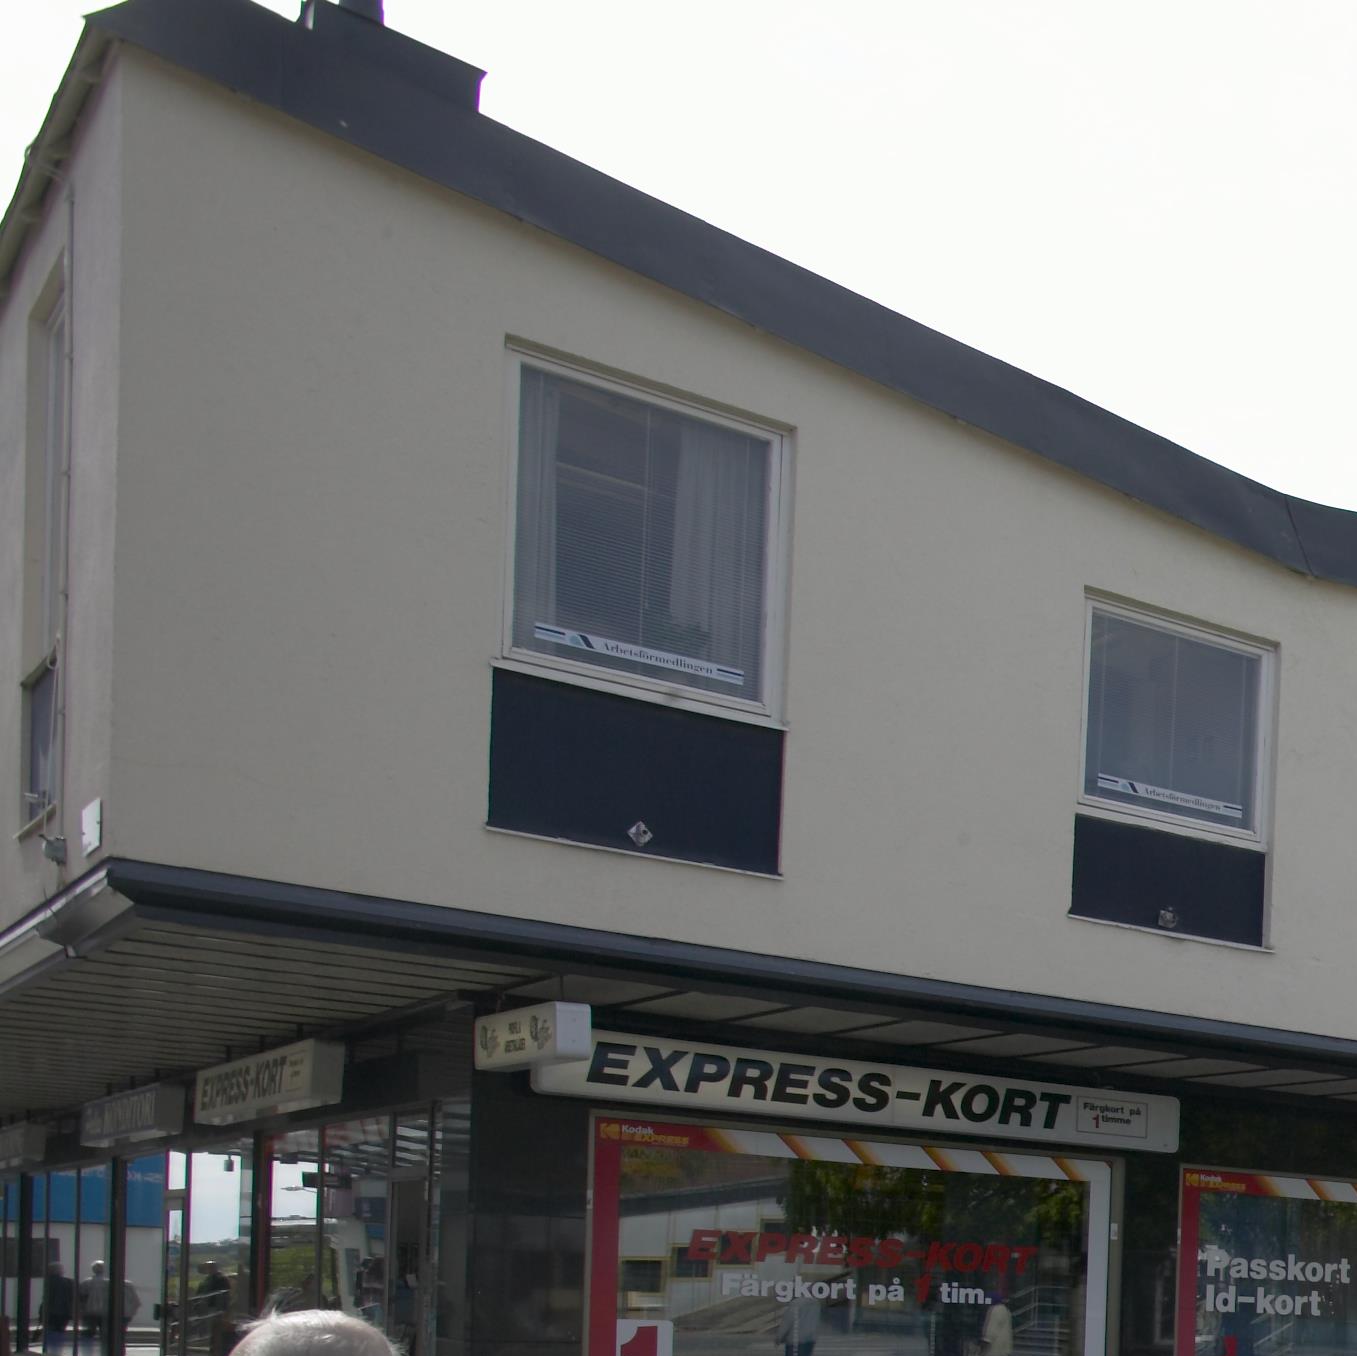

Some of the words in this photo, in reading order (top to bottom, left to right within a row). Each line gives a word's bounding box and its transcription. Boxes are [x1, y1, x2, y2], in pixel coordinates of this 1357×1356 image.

[603, 641, 713, 675] Arbetsförmedlingen
[200, 1056, 287, 1111] EXPRESS-KORT
[586, 1042, 1071, 1131] EXPRESS-KORT
[1083, 1102, 1124, 1115] Färgkort
[1129, 1107, 1142, 1117] på
[1092, 1113, 1100, 1128] 1
[1101, 1115, 1131, 1125] timme
[622, 1124, 654, 1135] Kodak
[687, 1229, 1039, 1276] EXPRESS-KORT
[1206, 1250, 1351, 1284] Passkort
[721, 1272, 857, 1303] Färgkort
[868, 1277, 905, 1305] på
[914, 1273, 931, 1304] 1
[940, 1281, 993, 1305] tim.
[1206, 1284, 1321, 1316] Id-kort
